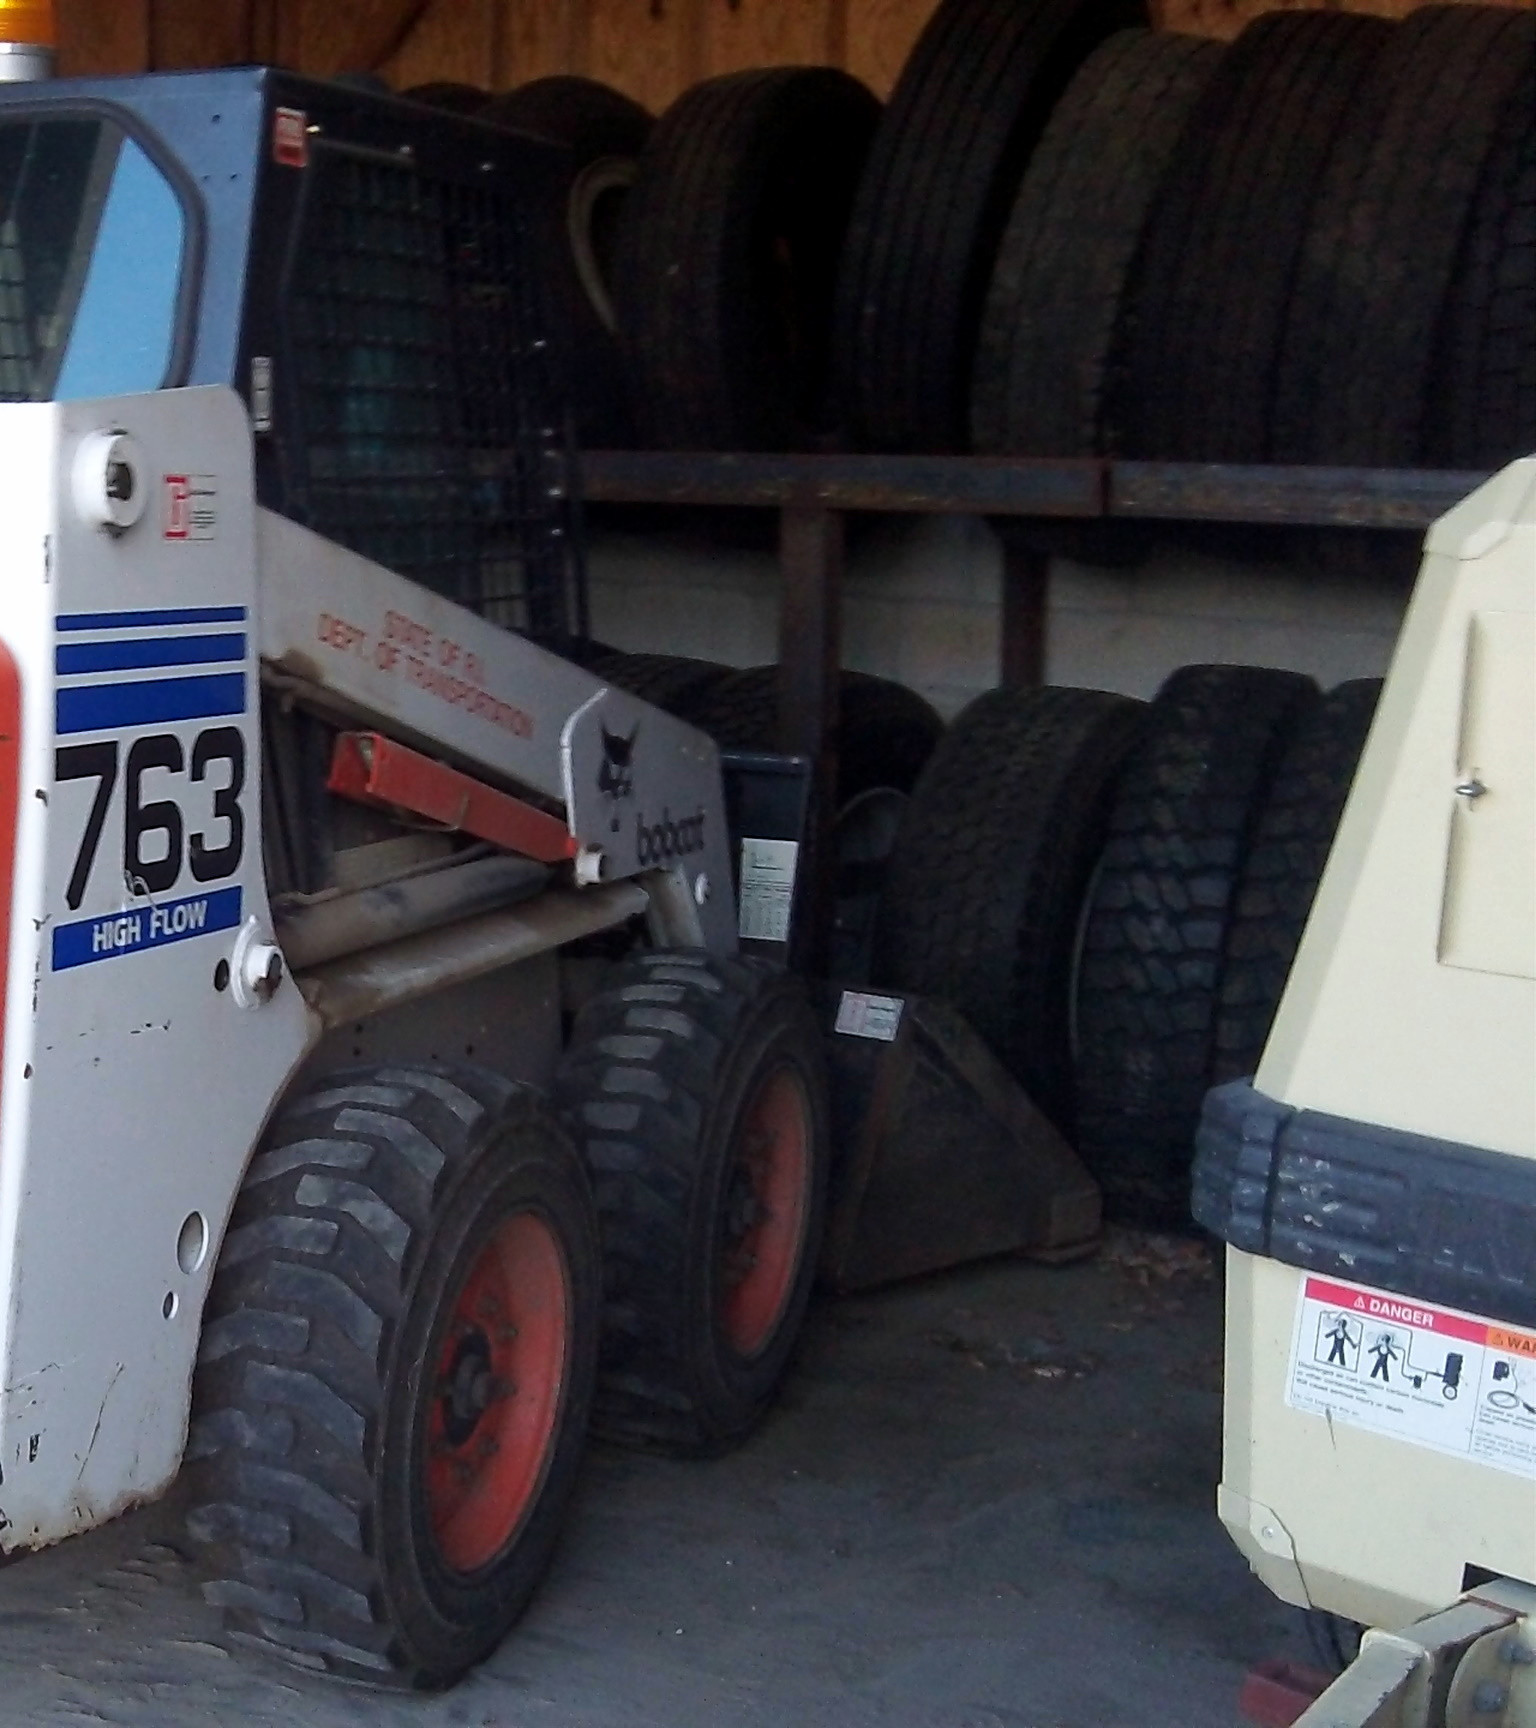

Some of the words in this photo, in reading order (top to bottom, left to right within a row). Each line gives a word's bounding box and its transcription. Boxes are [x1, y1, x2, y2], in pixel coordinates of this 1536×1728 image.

[439, 637, 462, 667] OF
[375, 640, 402, 672] OF
[405, 653, 535, 742] TRANSPORTATION
[55, 725, 245, 911] 763
[636, 806, 705, 867] bobcat
[93, 914, 141, 953] HIGH
[149, 899, 209, 939] FLOW
[1369, 1297, 1435, 1328] DANGER
